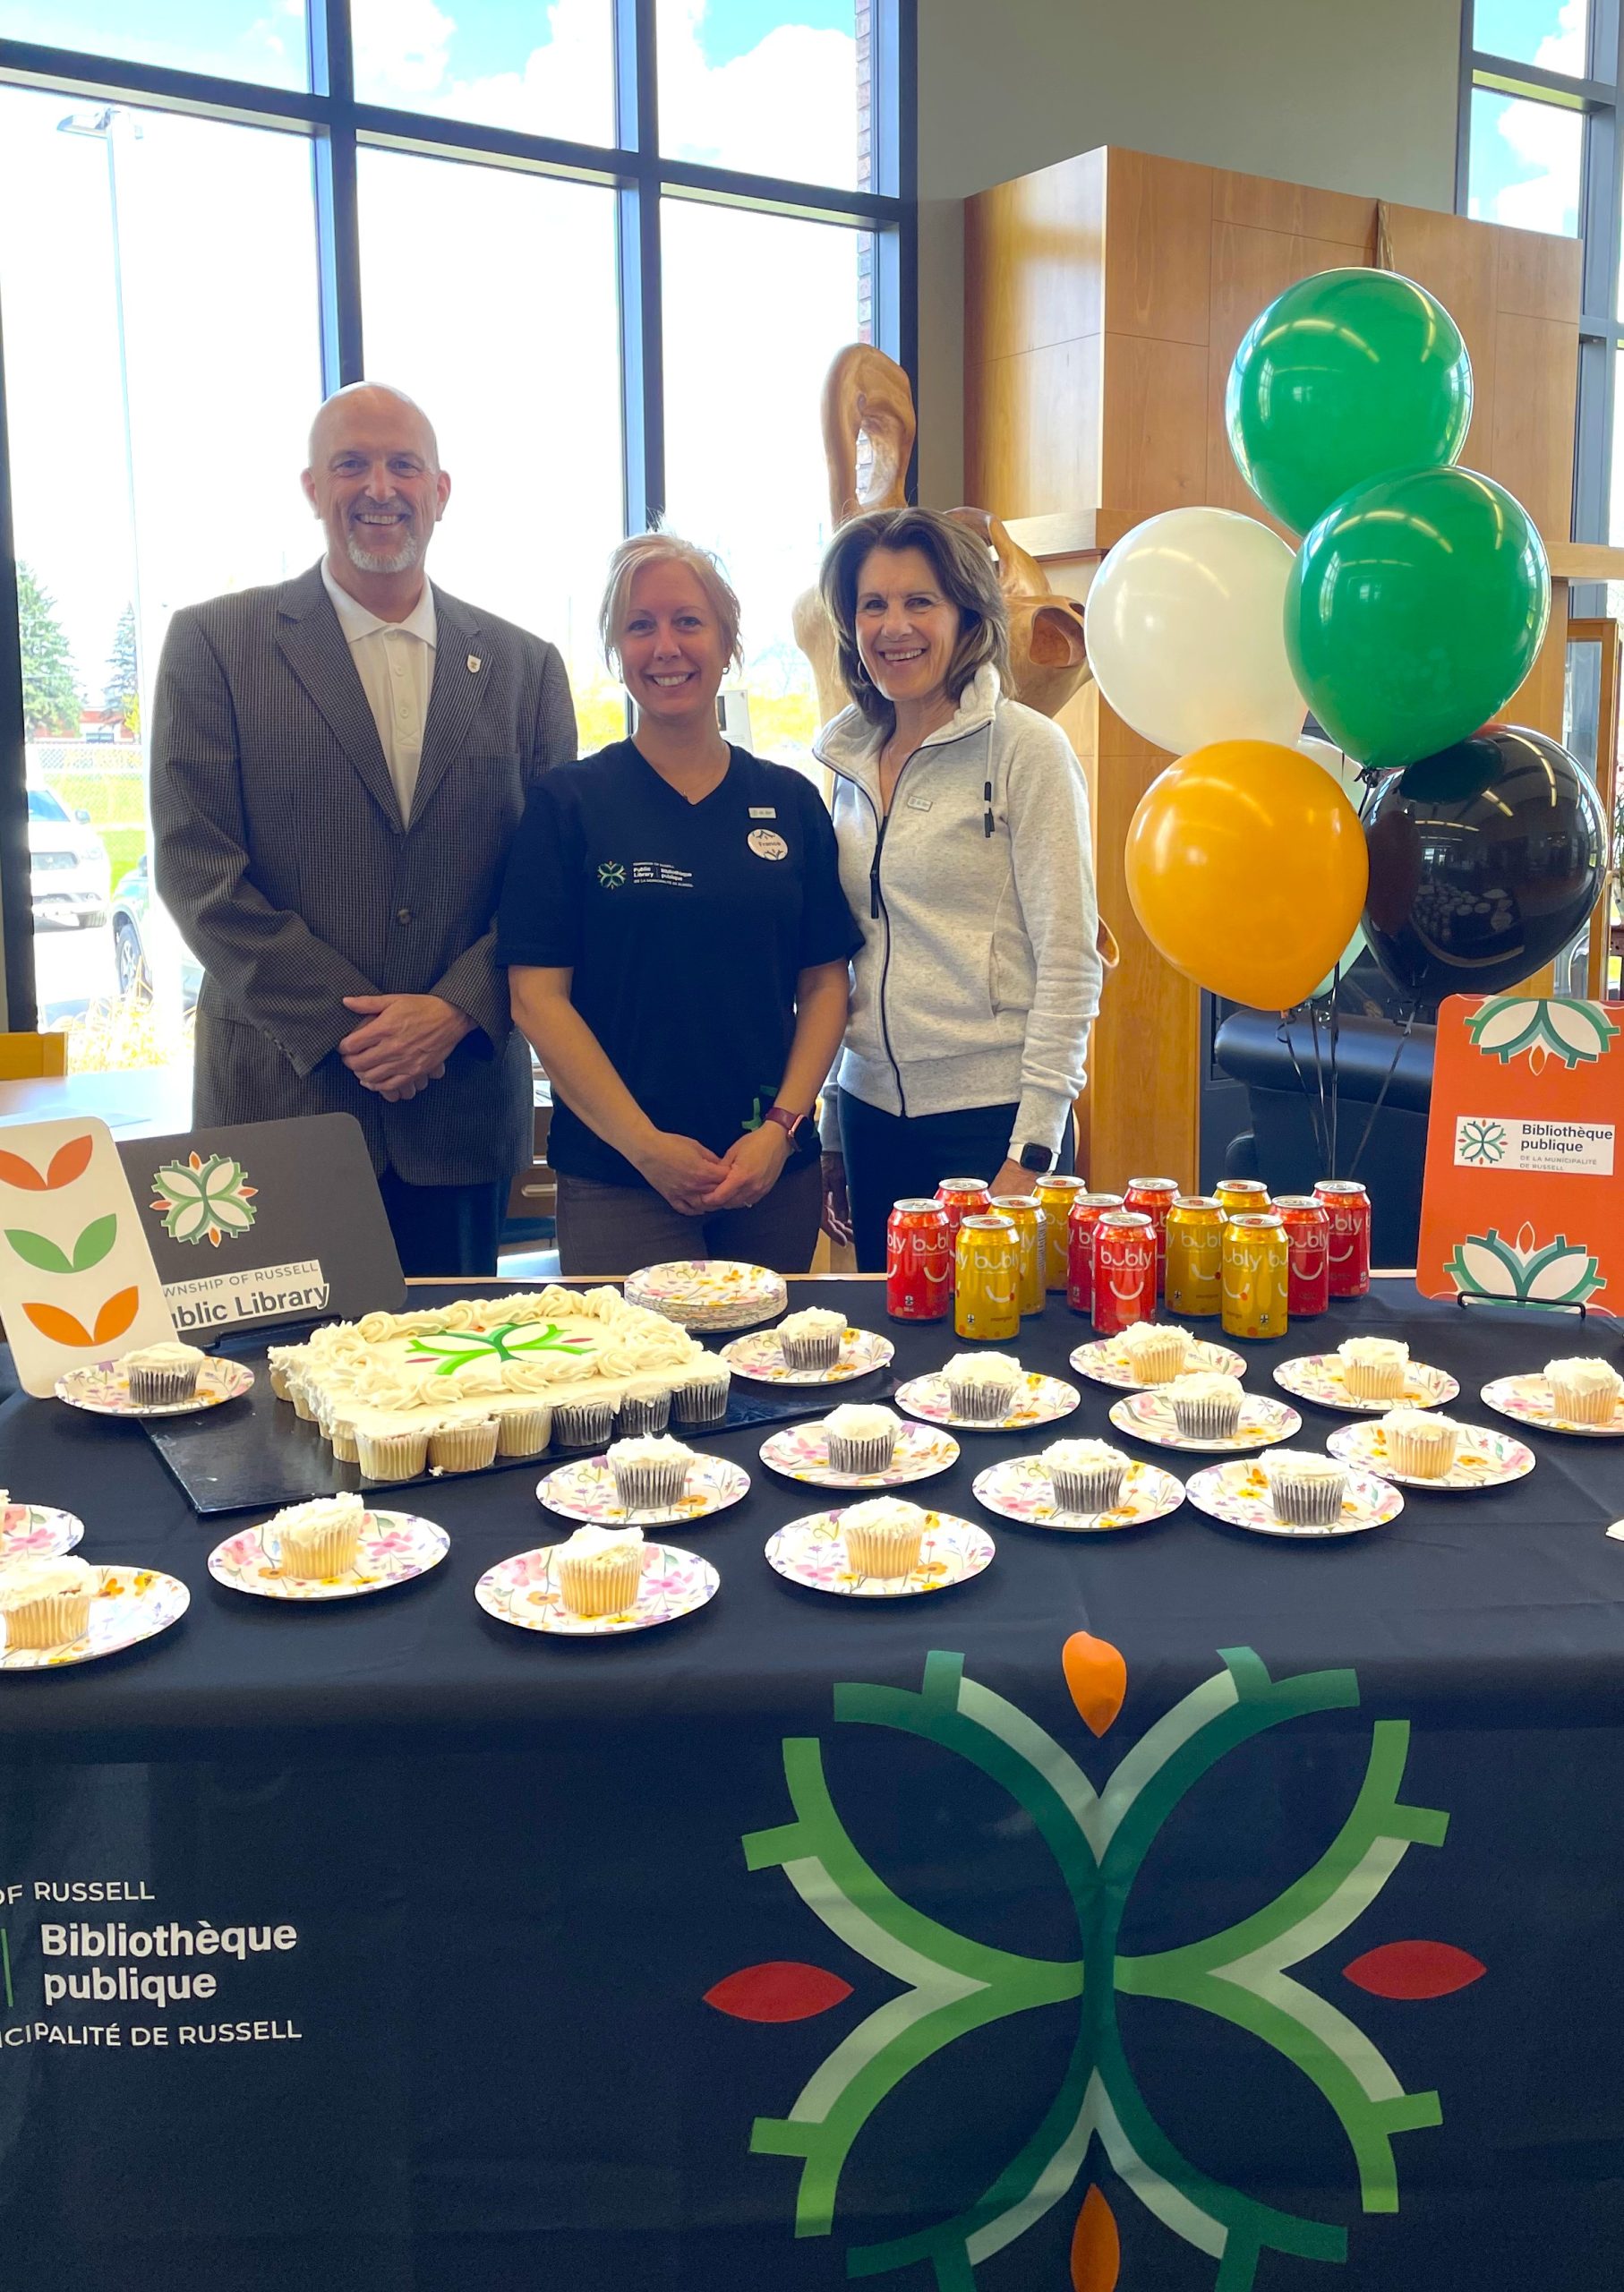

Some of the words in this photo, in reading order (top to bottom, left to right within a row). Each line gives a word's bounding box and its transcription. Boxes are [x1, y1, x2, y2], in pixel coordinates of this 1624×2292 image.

[1521, 1139, 1584, 1153] publique
[1522, 1124, 1613, 1142] Bibliothèque
[1100, 1244, 1153, 1270] bubly
[229, 1274, 249, 1286] OF
[255, 1262, 319, 1282] RUSSELL
[235, 1286, 328, 1317] Library
[0, 1884, 22, 1905] F
[34, 1881, 156, 1903] RUSSELL
[41, 1920, 297, 1960] Bibliothèque
[44, 1967, 218, 2007] publique
[131, 2027, 168, 2046] DE
[179, 2020, 303, 2045] RUSSELL
